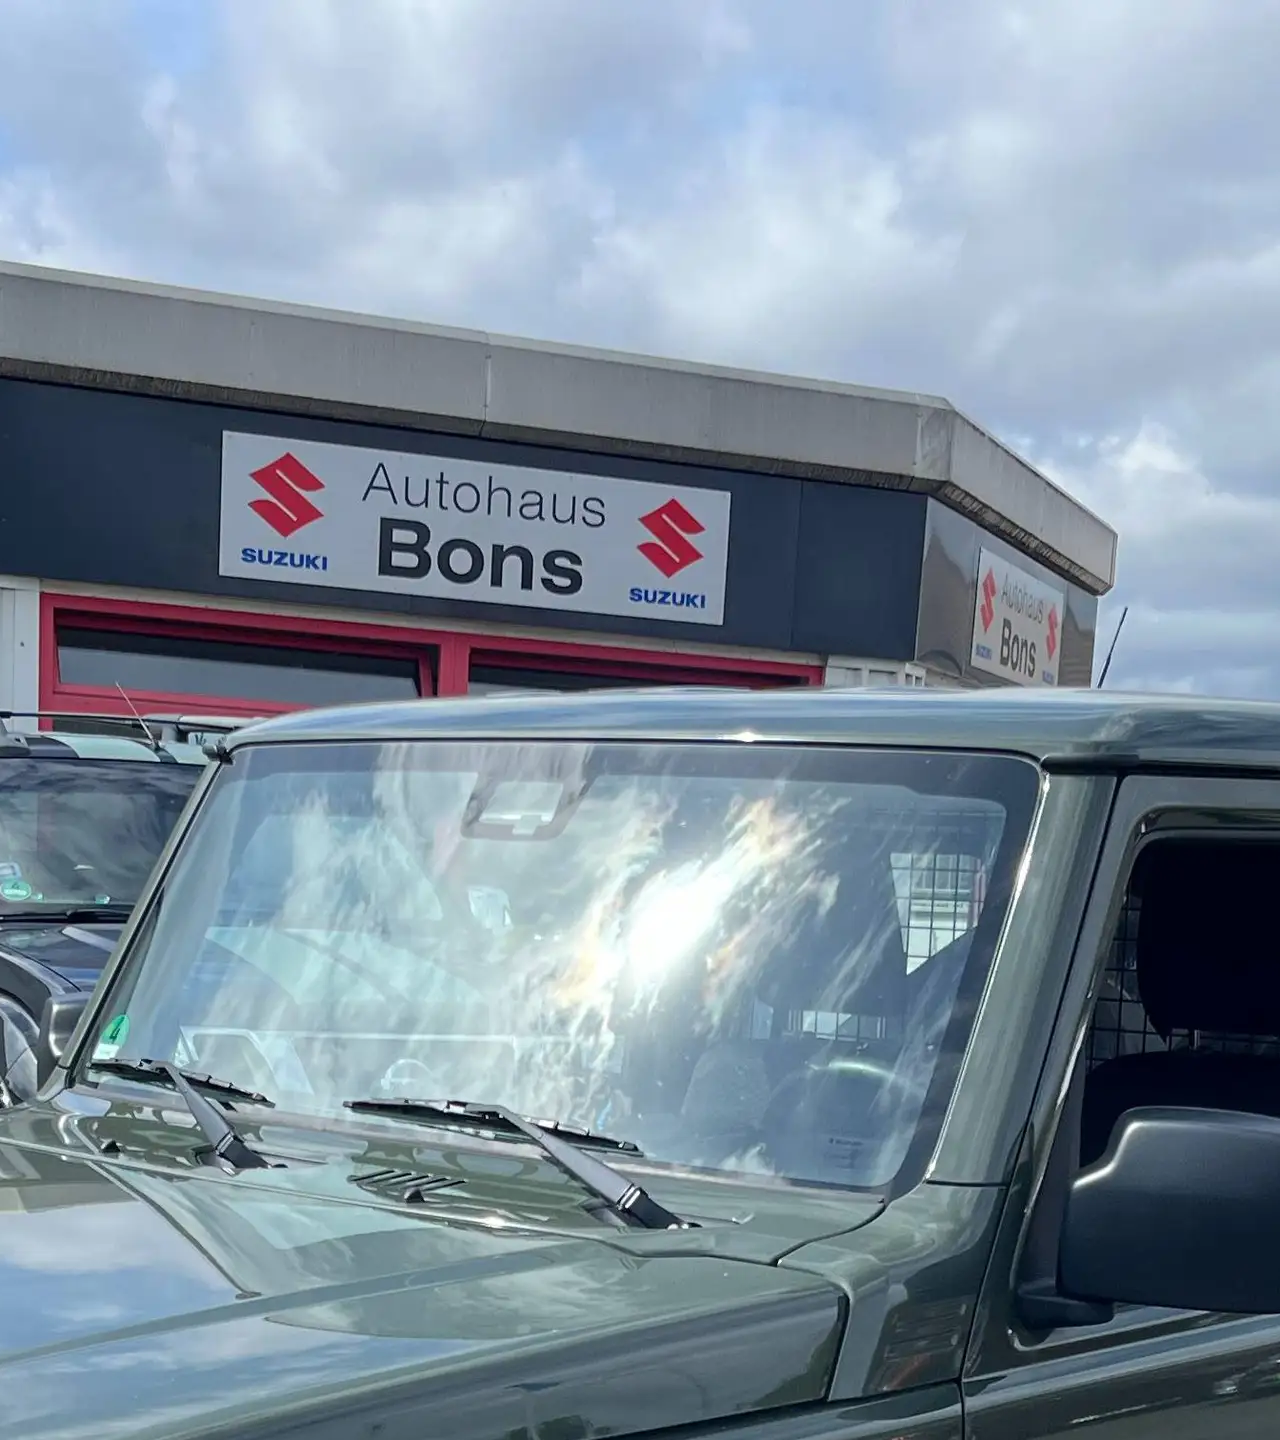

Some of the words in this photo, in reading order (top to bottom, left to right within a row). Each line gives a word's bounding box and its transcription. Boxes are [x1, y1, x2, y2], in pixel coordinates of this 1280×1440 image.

[362, 462, 606, 528] Autohaus
[241, 547, 328, 571] SUZUKI
[377, 516, 583, 595] Bons
[628, 587, 706, 609] SUZUKI
[1000, 572, 1044, 625] Autohaus
[1000, 618, 1037, 678] Bons
[109, 1016, 125, 1044] 4
